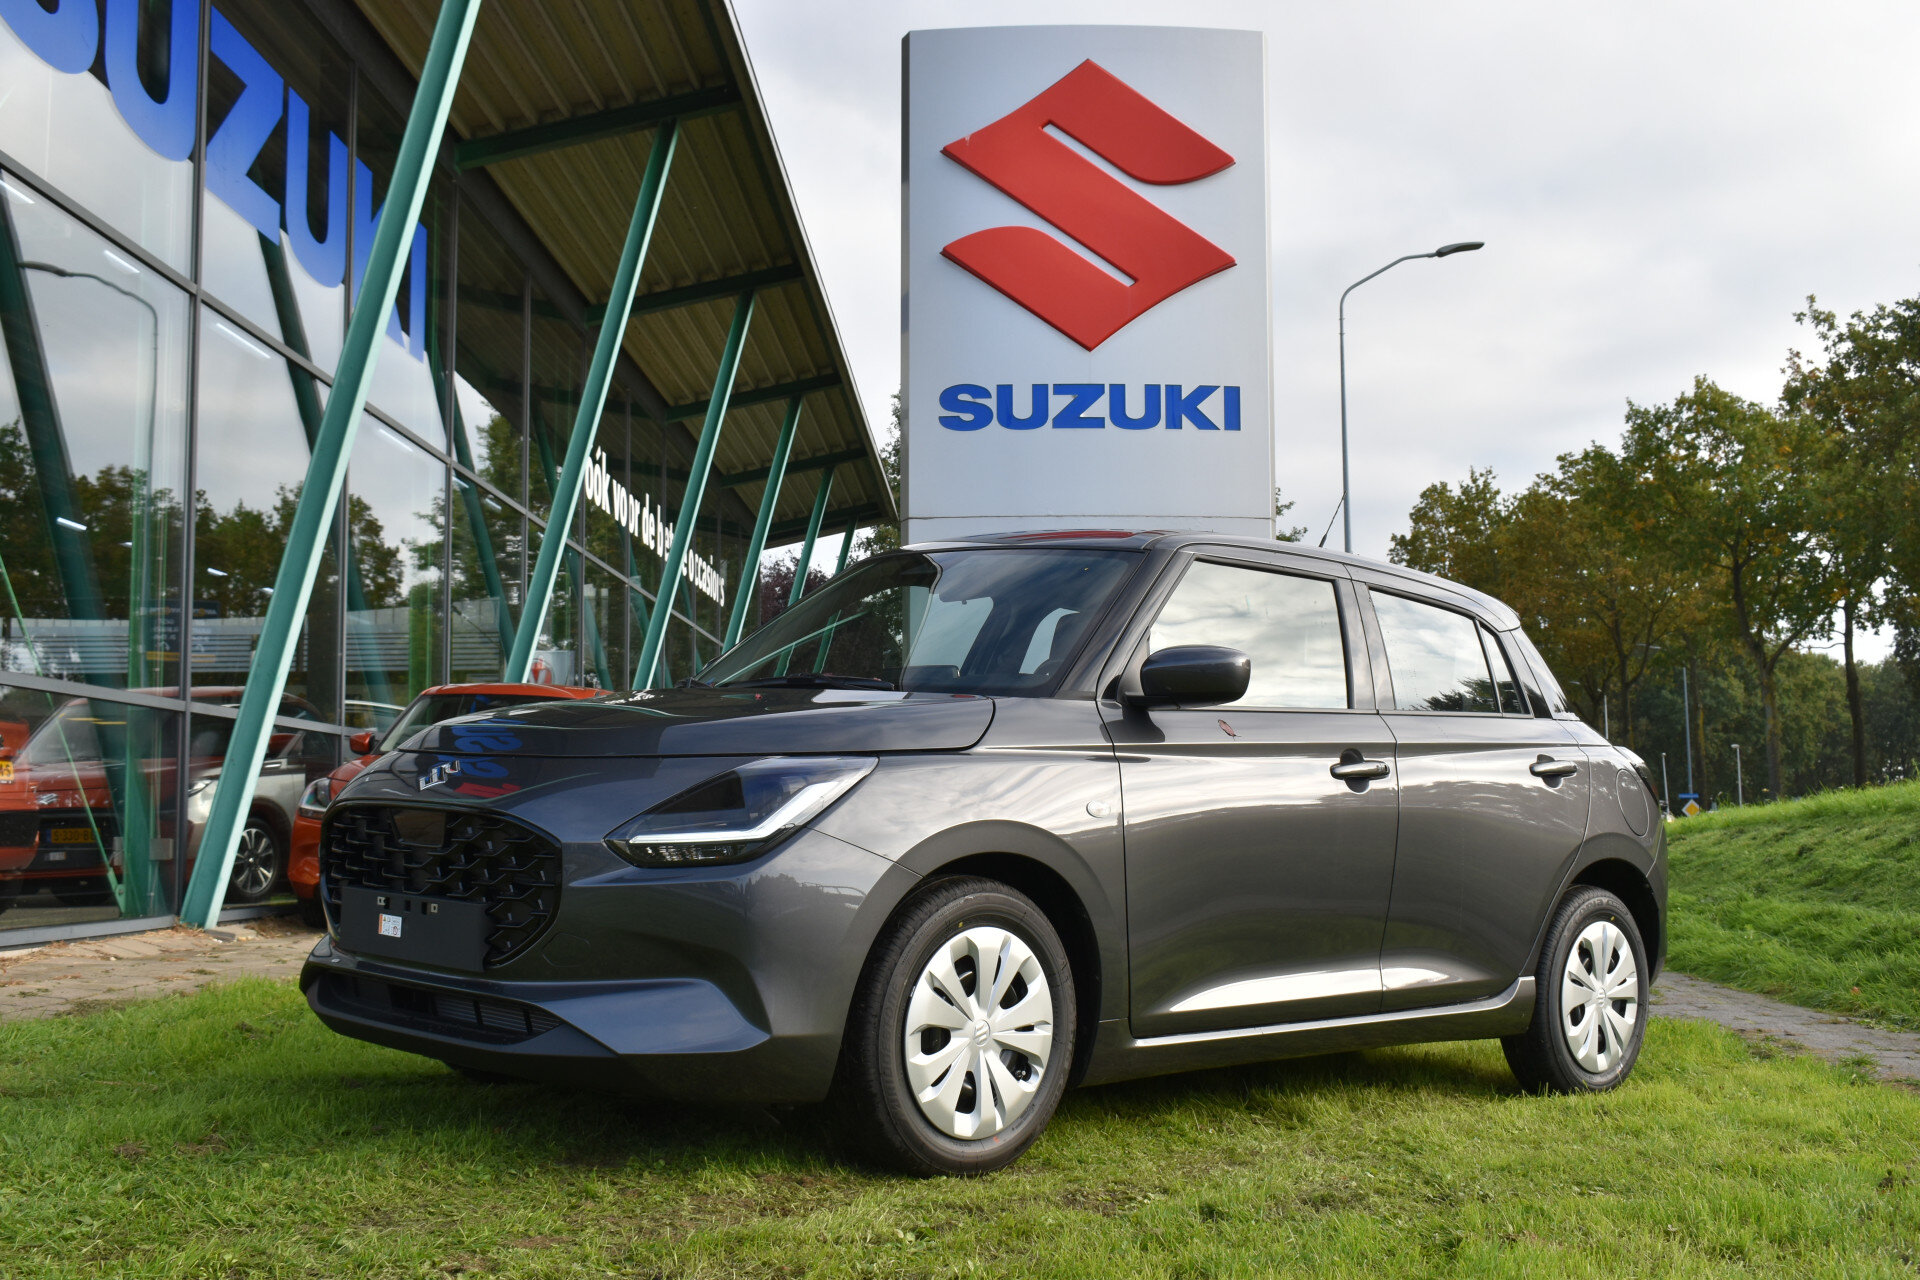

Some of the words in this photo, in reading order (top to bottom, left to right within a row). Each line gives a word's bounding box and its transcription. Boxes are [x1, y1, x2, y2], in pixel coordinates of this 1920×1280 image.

[938, 383, 1242, 432] SUZUKI
[612, 478, 641, 537] voor
[641, 493, 656, 550] de
